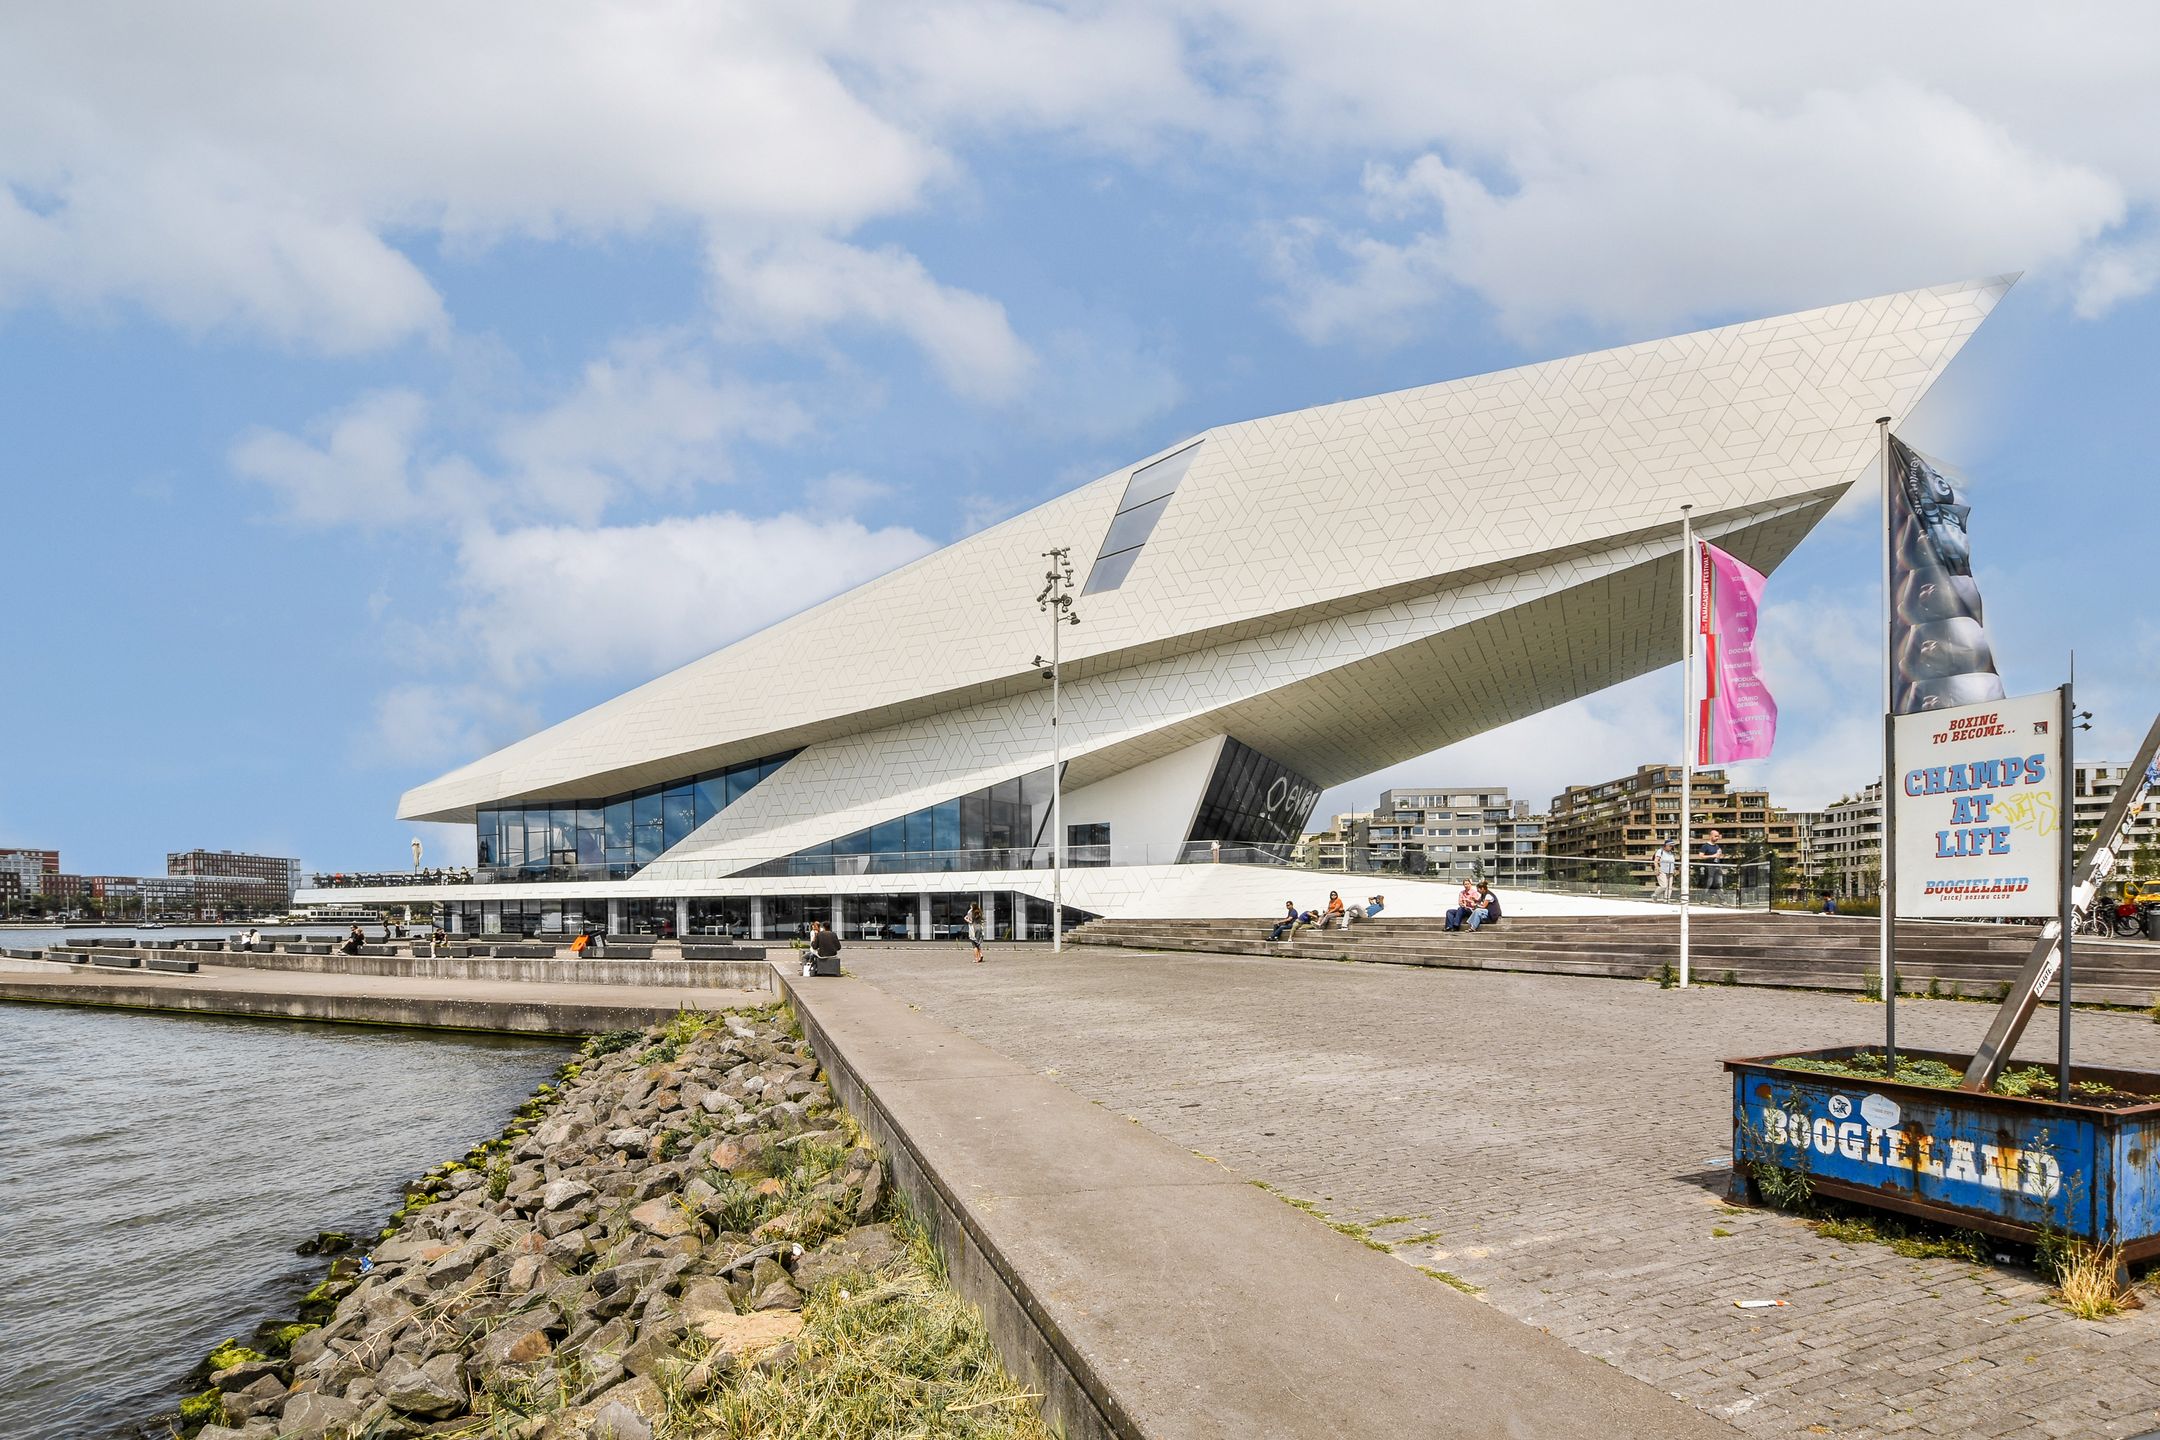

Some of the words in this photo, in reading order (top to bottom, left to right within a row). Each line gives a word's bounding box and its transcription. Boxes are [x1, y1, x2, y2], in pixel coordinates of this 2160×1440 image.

[1932, 734, 1948, 744] TO
[1951, 725, 2016, 742] BECOME...
[1949, 713, 1998, 731] BOXING
[1905, 754, 2046, 797] CHAMPS
[1950, 794, 1994, 824] AT
[1935, 826, 2011, 858] LIFE
[1924, 877, 2029, 895] BOOGIELAND
[1763, 1107, 2060, 1198] BOOGIELAND
